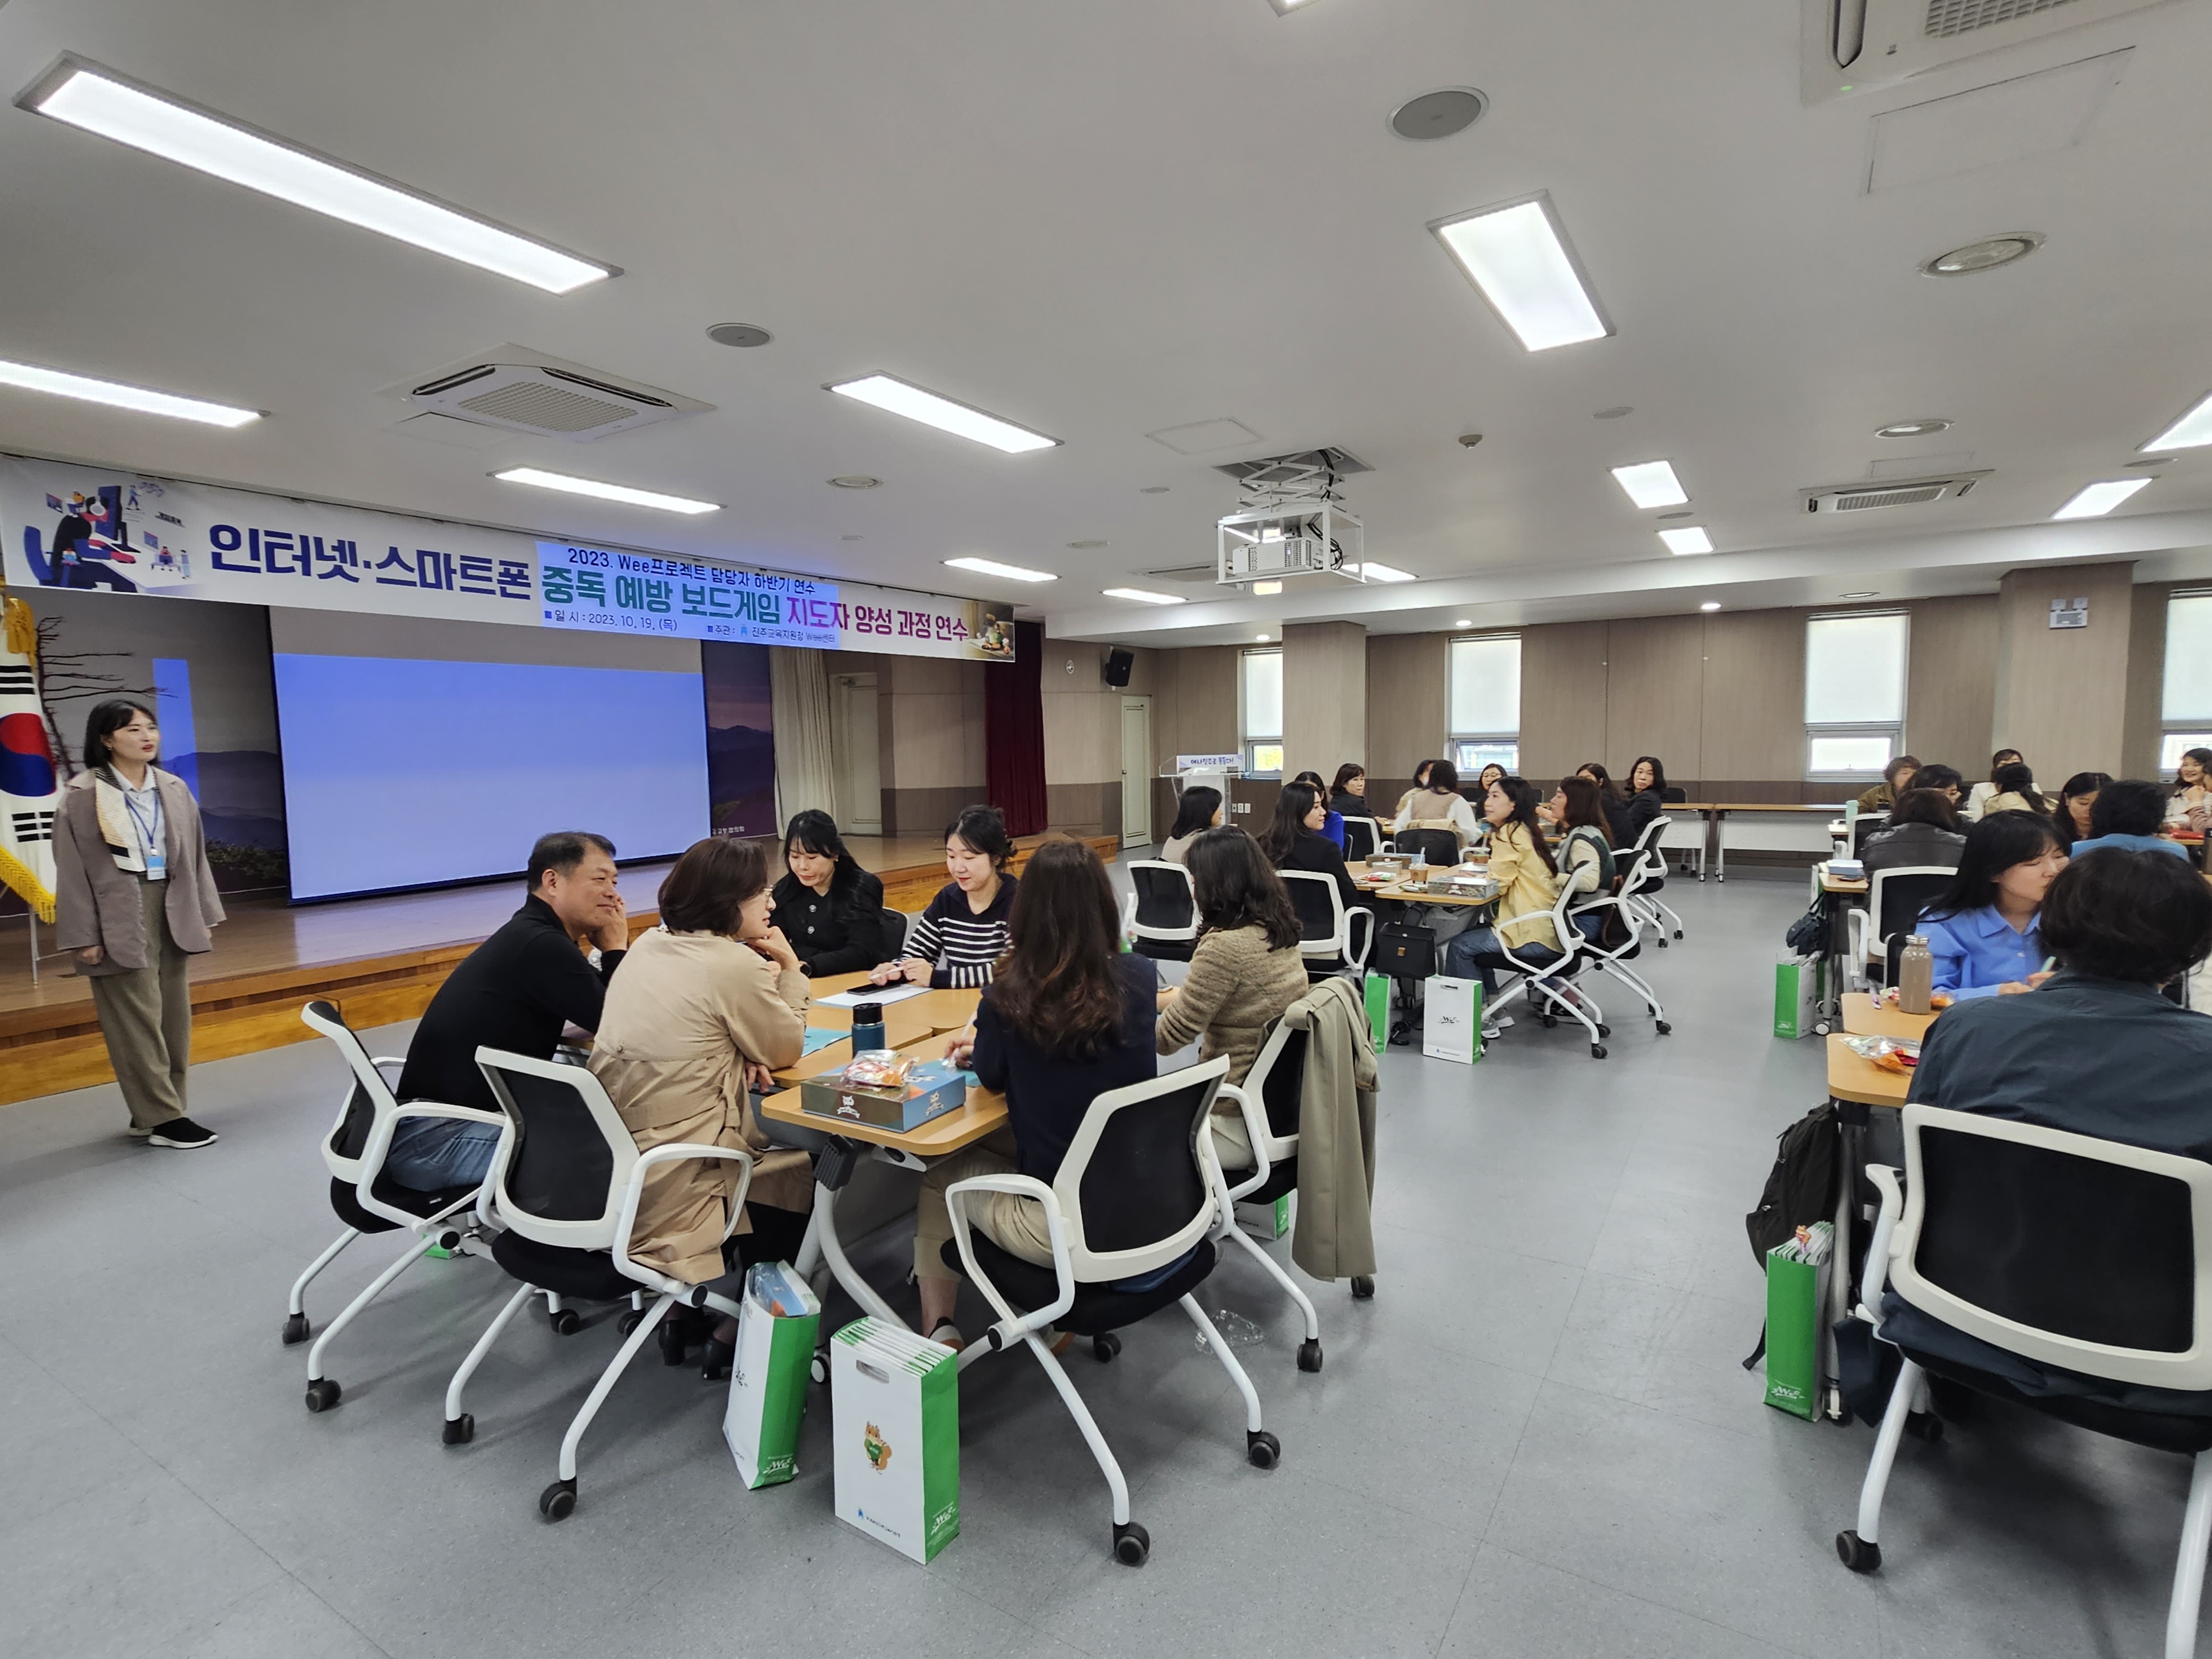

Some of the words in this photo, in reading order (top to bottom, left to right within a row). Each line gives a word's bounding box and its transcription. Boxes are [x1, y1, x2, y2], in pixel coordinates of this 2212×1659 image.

[567, 548, 613, 568] 2023.
[618, 555, 707, 580] Wee프로젝트
[711, 568, 749, 587] 담당자
[754, 573, 790, 592] 하반기
[794, 580, 816, 595] 연수
[542, 565, 606, 607] 중독
[615, 575, 673, 613] 예방
[682, 583, 780, 625] 보드게임
[786, 597, 850, 630] 지도자
[855, 606, 893, 635] 양성
[897, 610, 931, 639] 과정
[935, 615, 969, 641] 연수
[752, 627, 804, 640] 진주교육지원청
